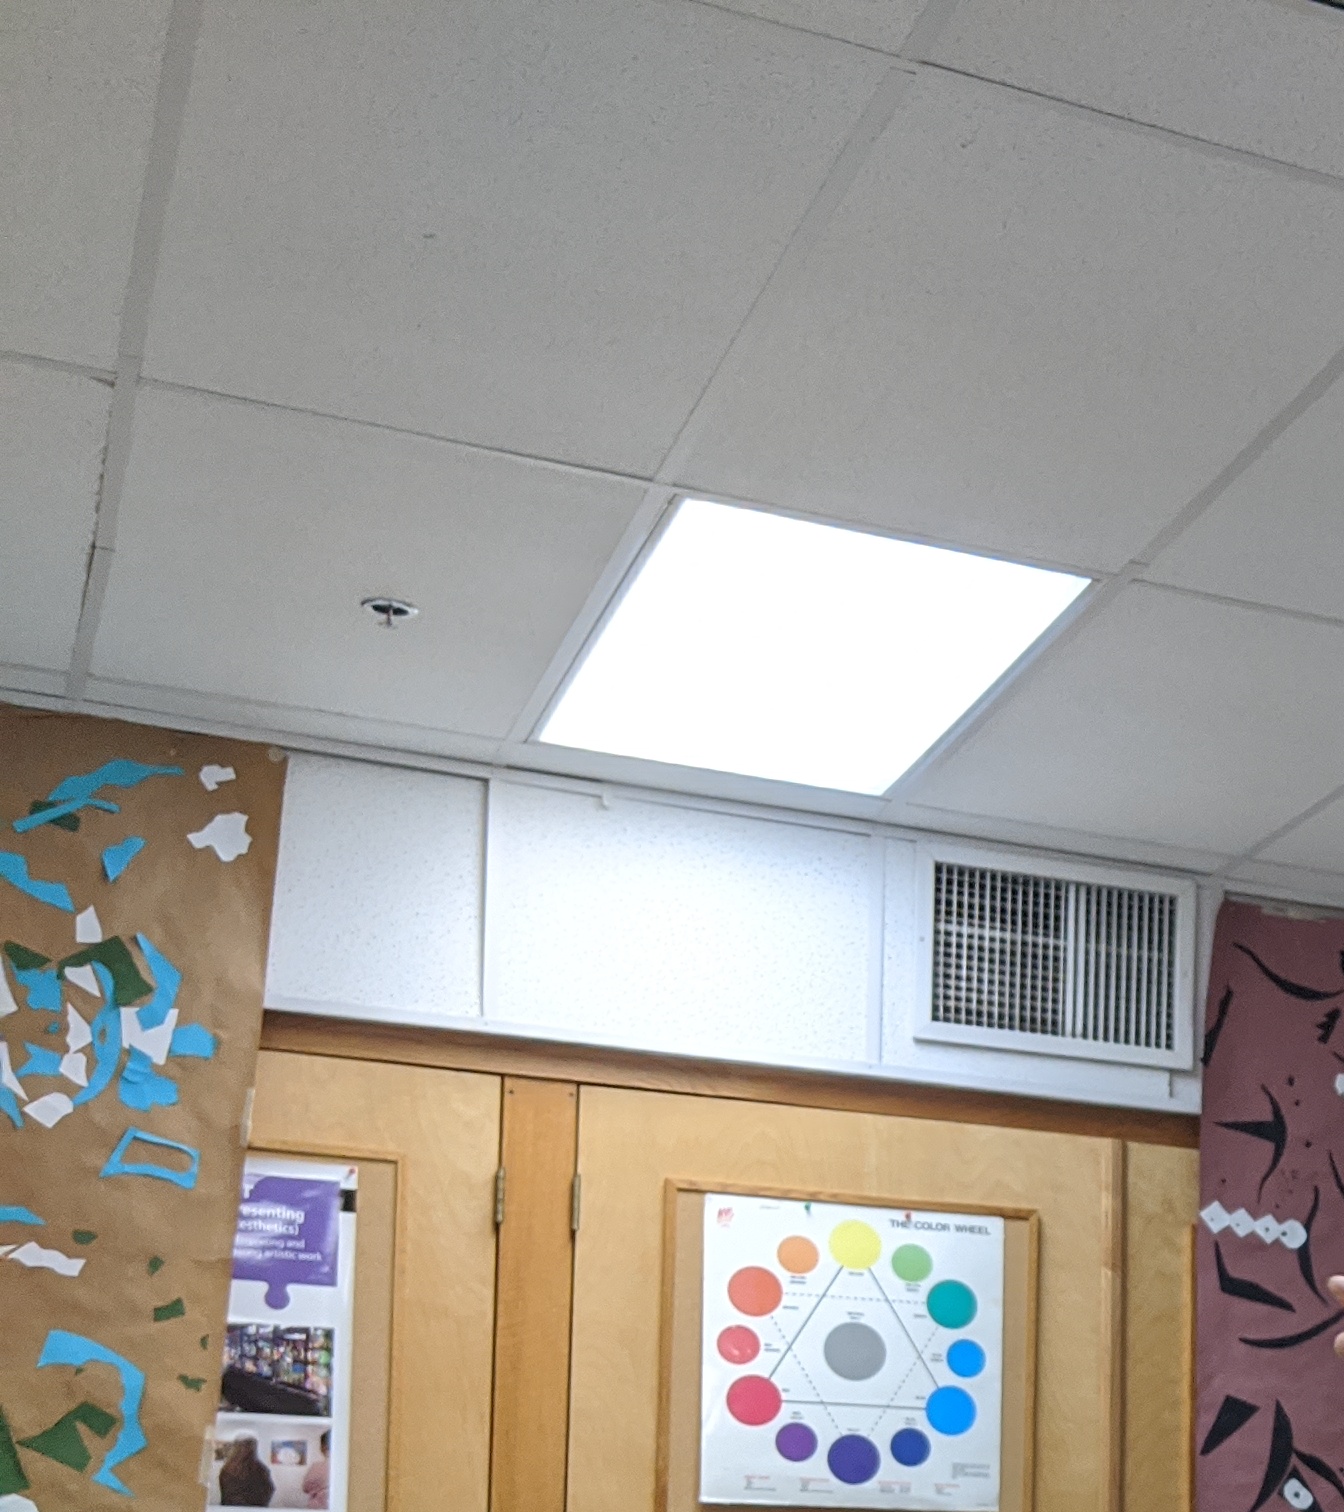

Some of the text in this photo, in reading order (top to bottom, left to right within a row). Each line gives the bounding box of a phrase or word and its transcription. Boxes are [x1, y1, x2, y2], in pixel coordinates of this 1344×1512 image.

[890, 1219, 991, 1235] THE COLOR WHEEL
